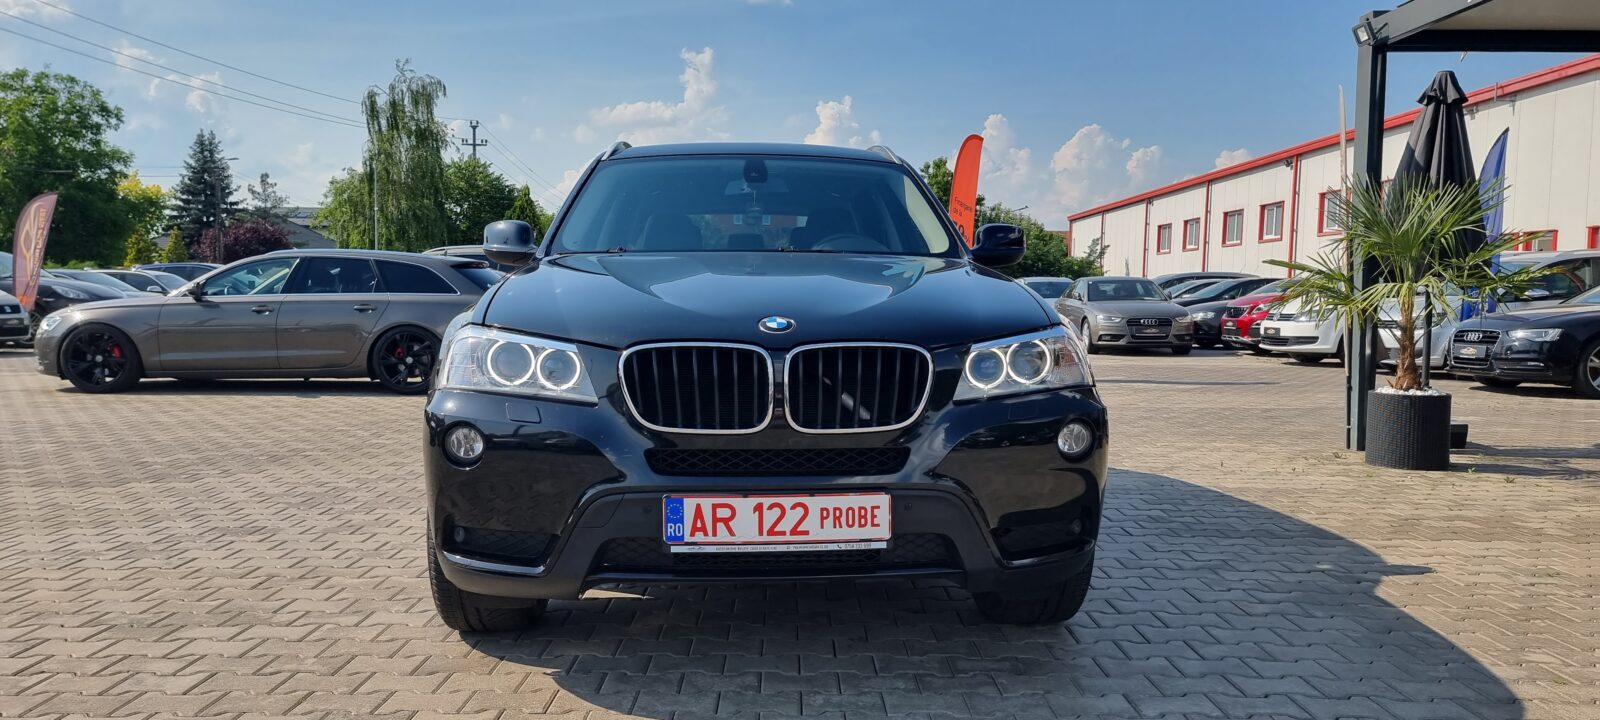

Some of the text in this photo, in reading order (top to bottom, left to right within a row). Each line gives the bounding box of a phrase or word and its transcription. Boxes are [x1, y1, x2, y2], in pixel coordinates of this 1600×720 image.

[667, 523, 683, 537] RO
[689, 502, 880, 537] AR 122 PROBE
